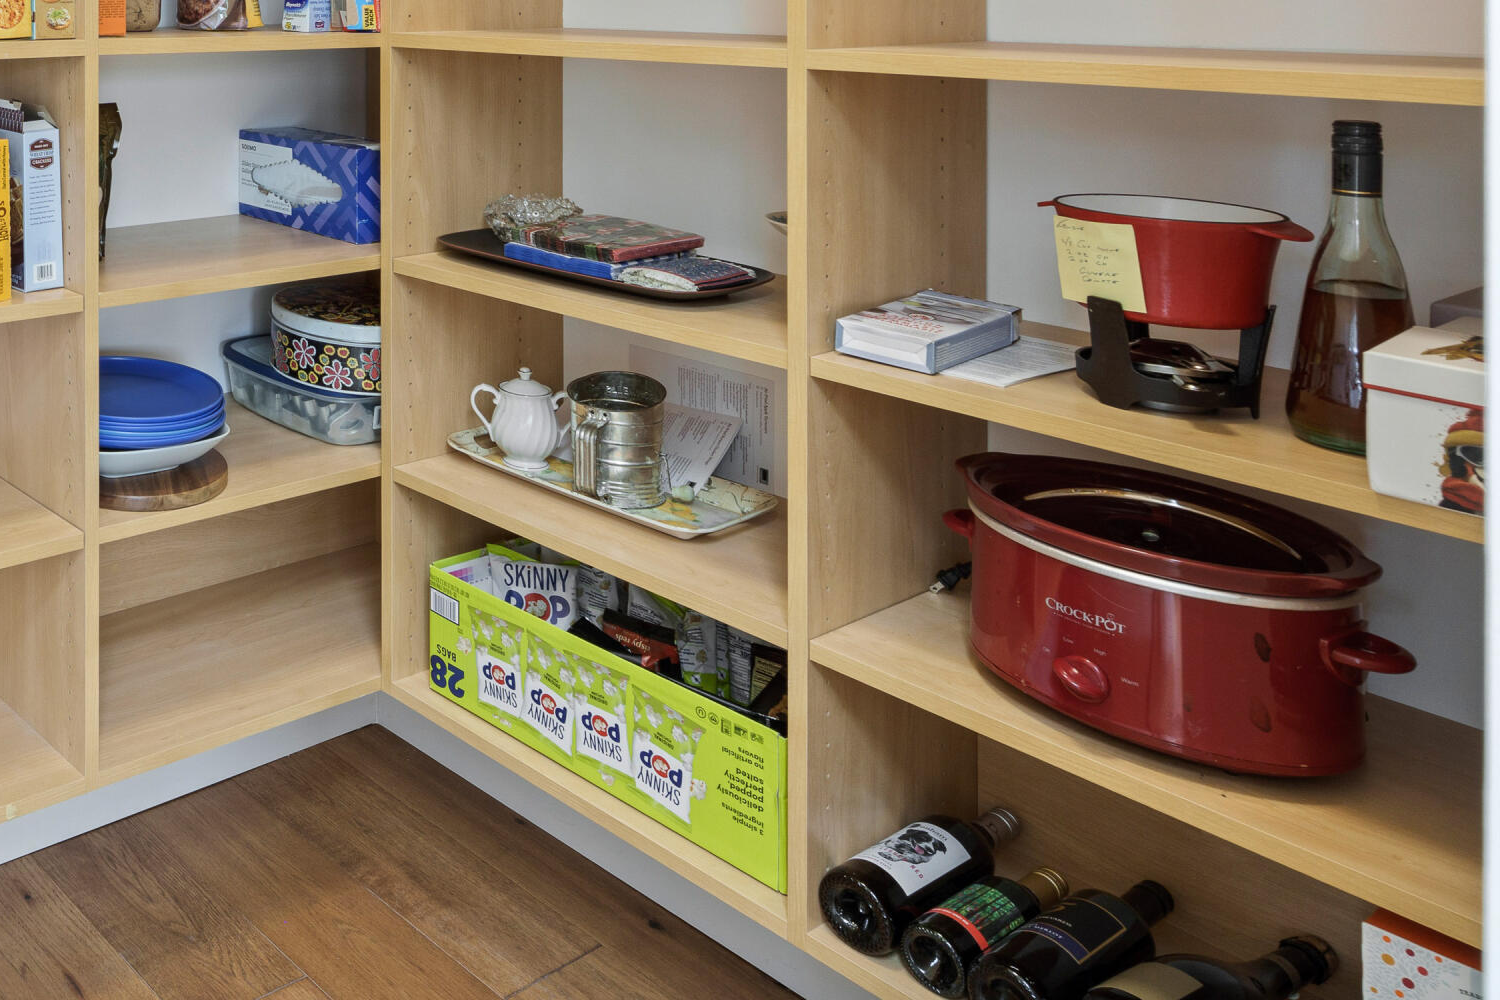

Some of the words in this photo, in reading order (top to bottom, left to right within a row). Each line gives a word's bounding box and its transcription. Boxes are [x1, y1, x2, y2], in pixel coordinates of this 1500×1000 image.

[615, 632, 631, 646] reds
[436, 644, 457, 662] BAGS
[430, 654, 465, 698] 28
[482, 661, 516, 691] POP
[530, 688, 567, 724] POP
[581, 711, 621, 743] POP
[722, 746, 753, 764] artificial
[738, 746, 764, 764] flavors
[754, 761, 764, 770] no
[640, 749, 683, 788] POP
[735, 767, 764, 785] salted
[724, 769, 764, 794] perfectly
[727, 780, 764, 803] popped,
[717, 783, 764, 812] deliciously
[721, 801, 764, 829] ingredients
[732, 815, 757, 832] simple
